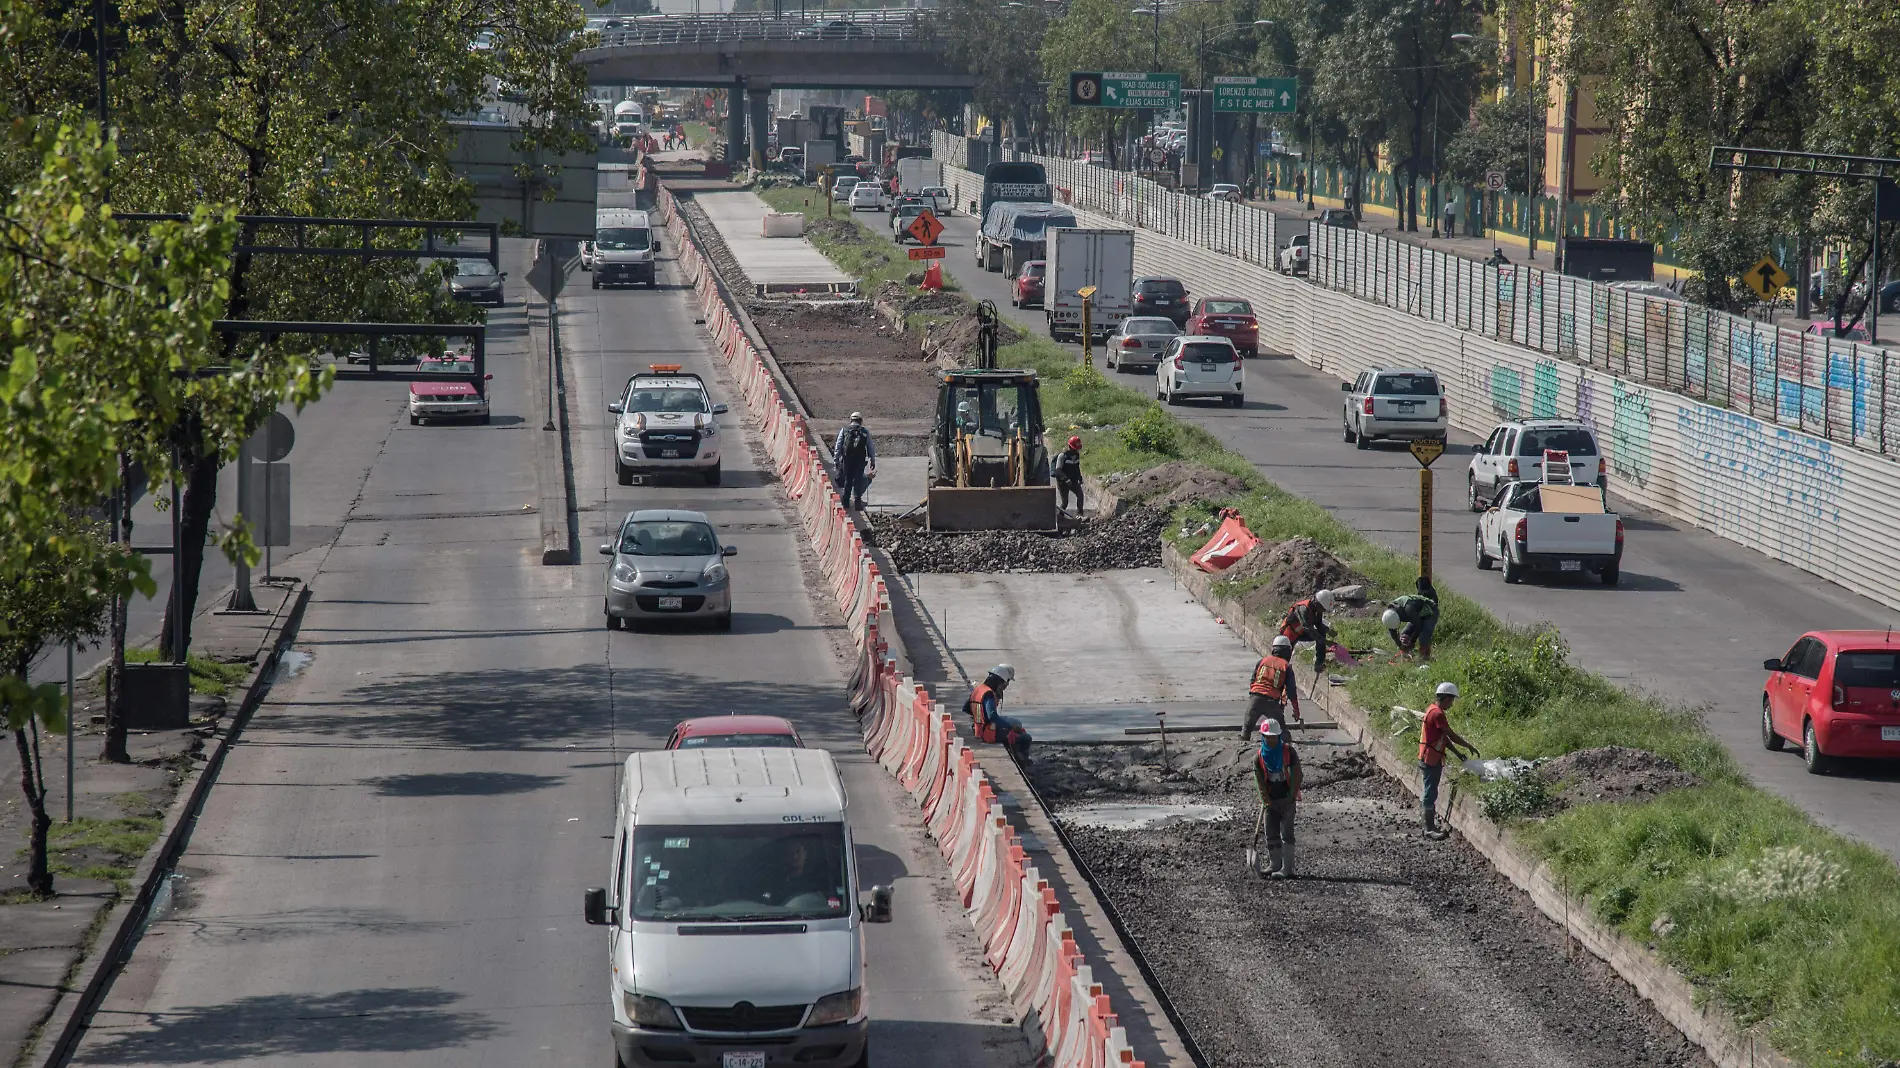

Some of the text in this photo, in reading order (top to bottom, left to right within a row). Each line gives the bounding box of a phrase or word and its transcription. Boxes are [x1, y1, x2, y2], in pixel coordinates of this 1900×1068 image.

[1219, 88, 1275, 96] LORENZO BOTURINI
[1228, 99, 1233, 107] S
[1236, 99, 1240, 107] T
[1243, 99, 1252, 107] DE
[1256, 99, 1274, 108] MIER
